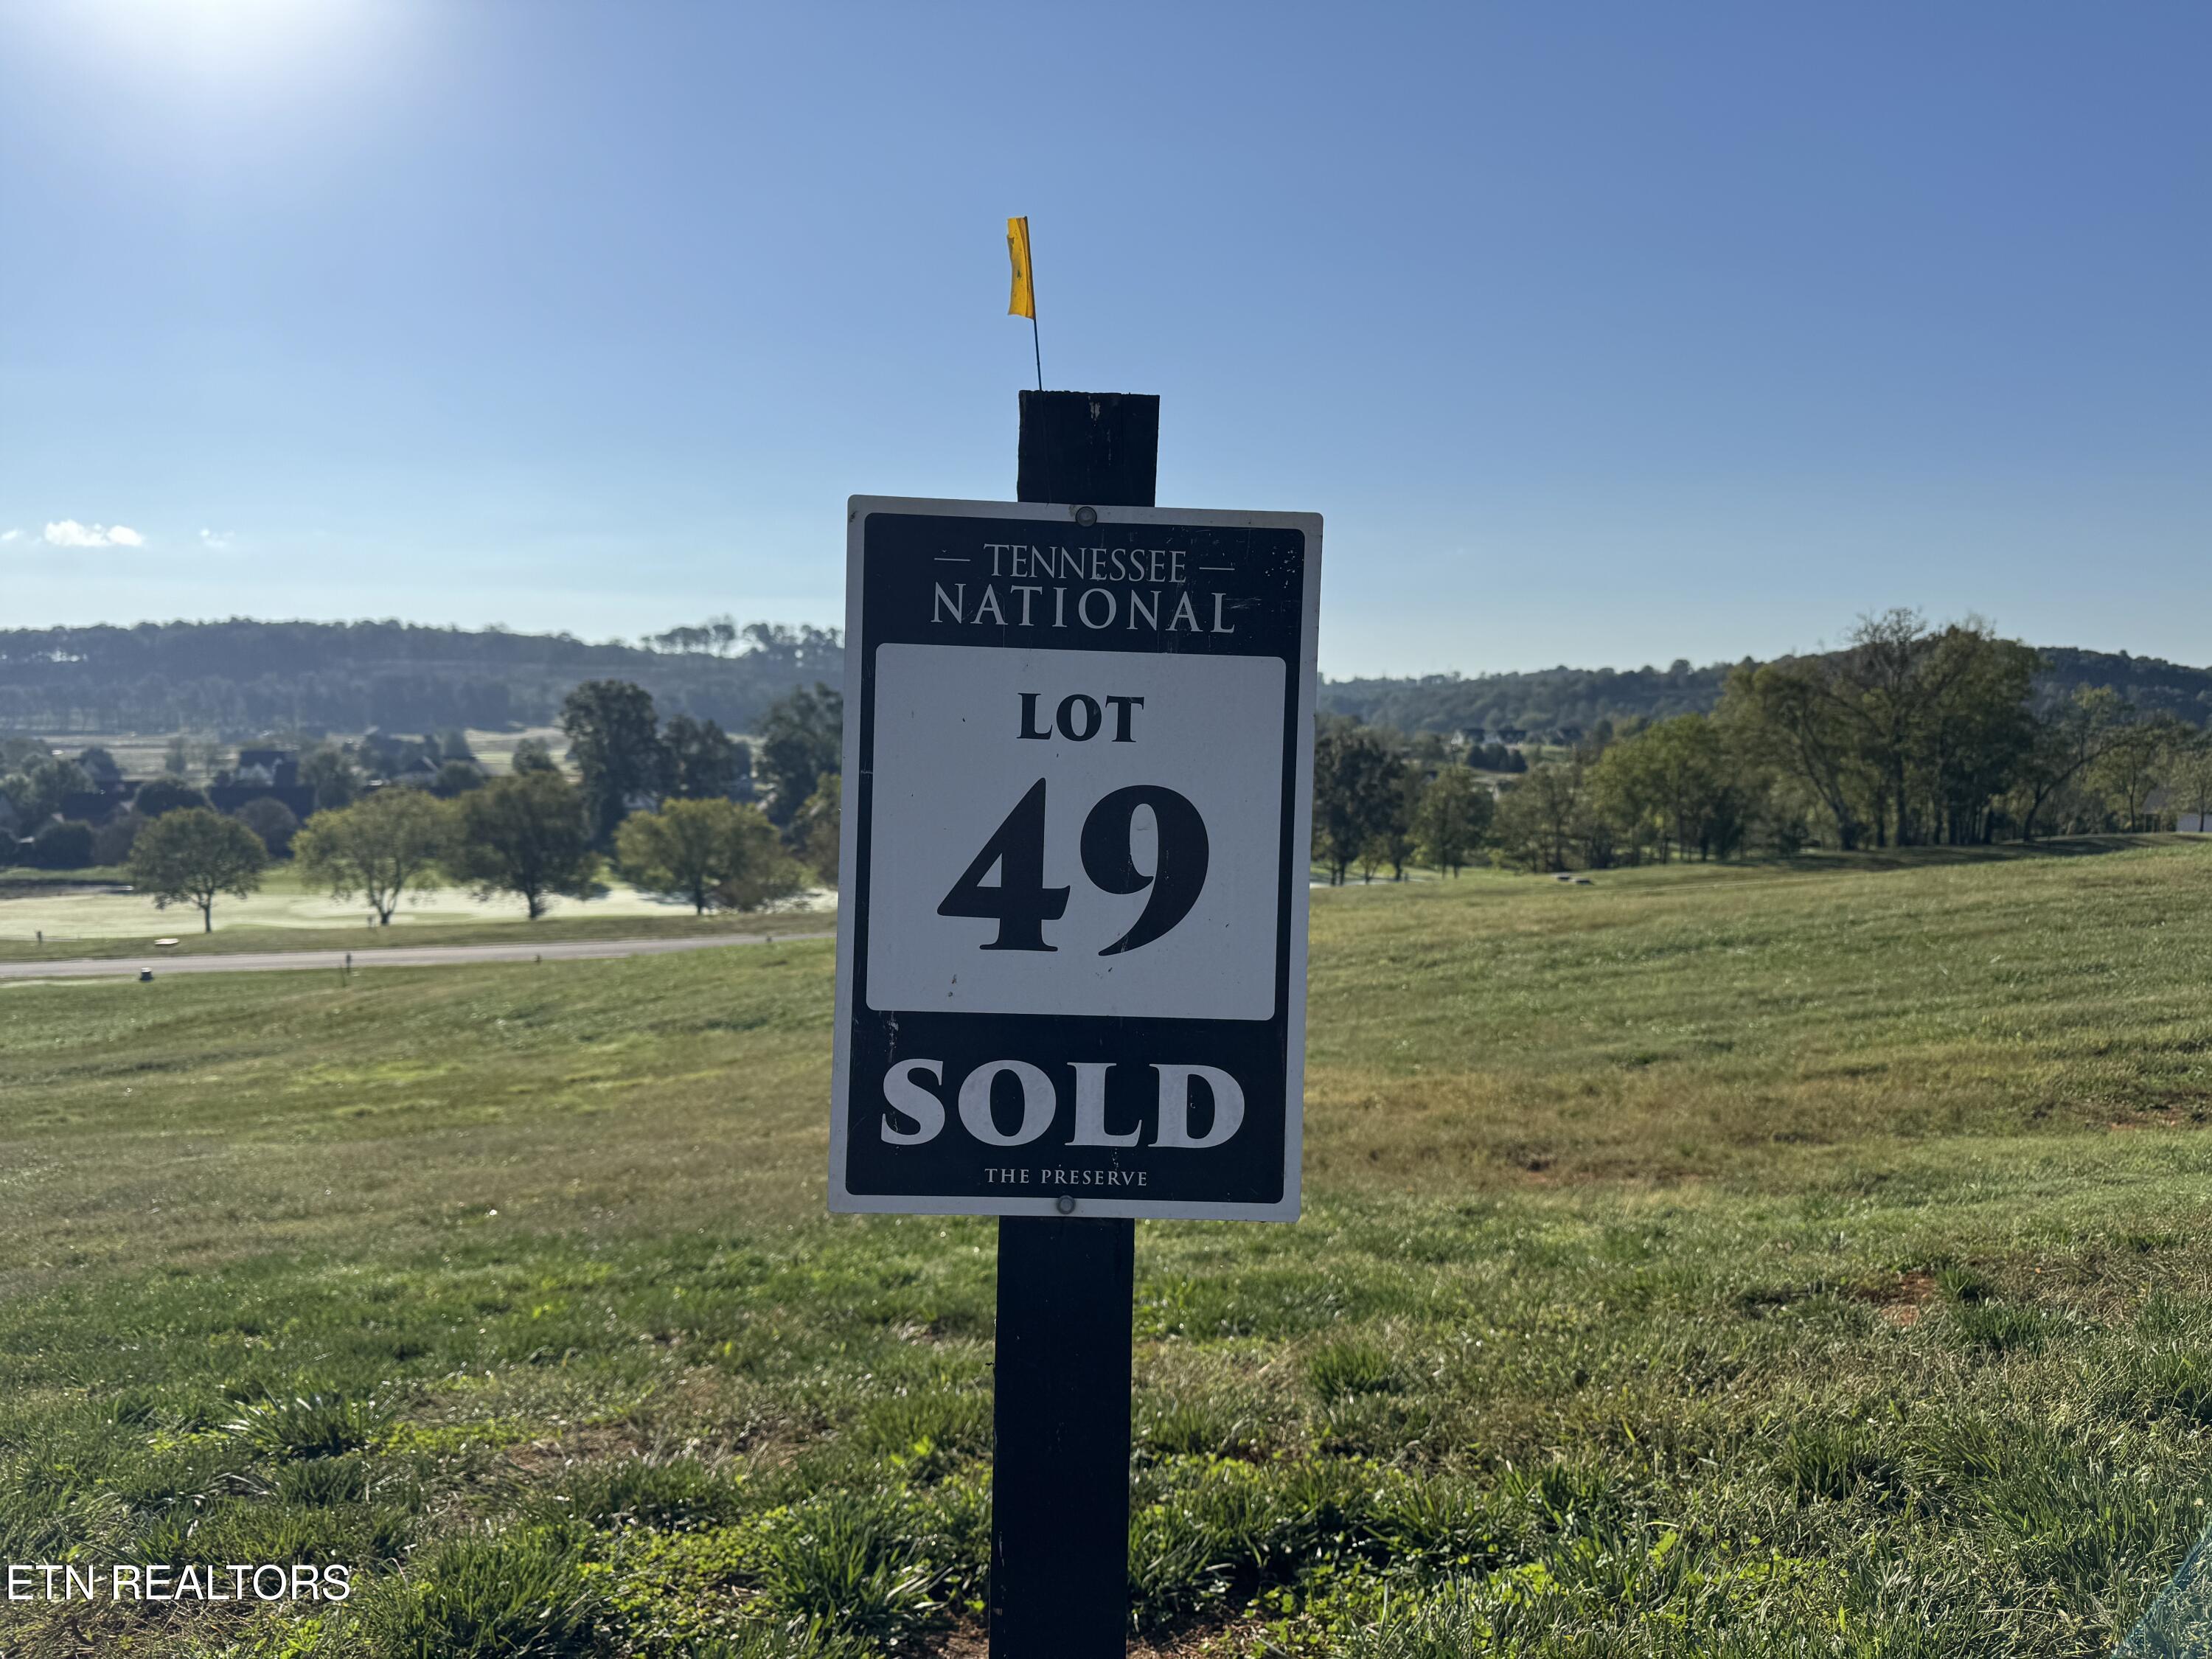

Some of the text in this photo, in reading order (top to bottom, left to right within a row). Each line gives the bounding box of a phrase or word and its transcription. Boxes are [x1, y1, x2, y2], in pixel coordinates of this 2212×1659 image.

[984, 543, 1186, 582] TENNESSEE
[930, 581, 1236, 634] NATIONAL
[1016, 692, 1145, 743] LOT
[936, 777, 1210, 956] 49
[880, 1058, 1246, 1149] SOLD
[984, 1167, 1149, 1187] THE PRESERVE
